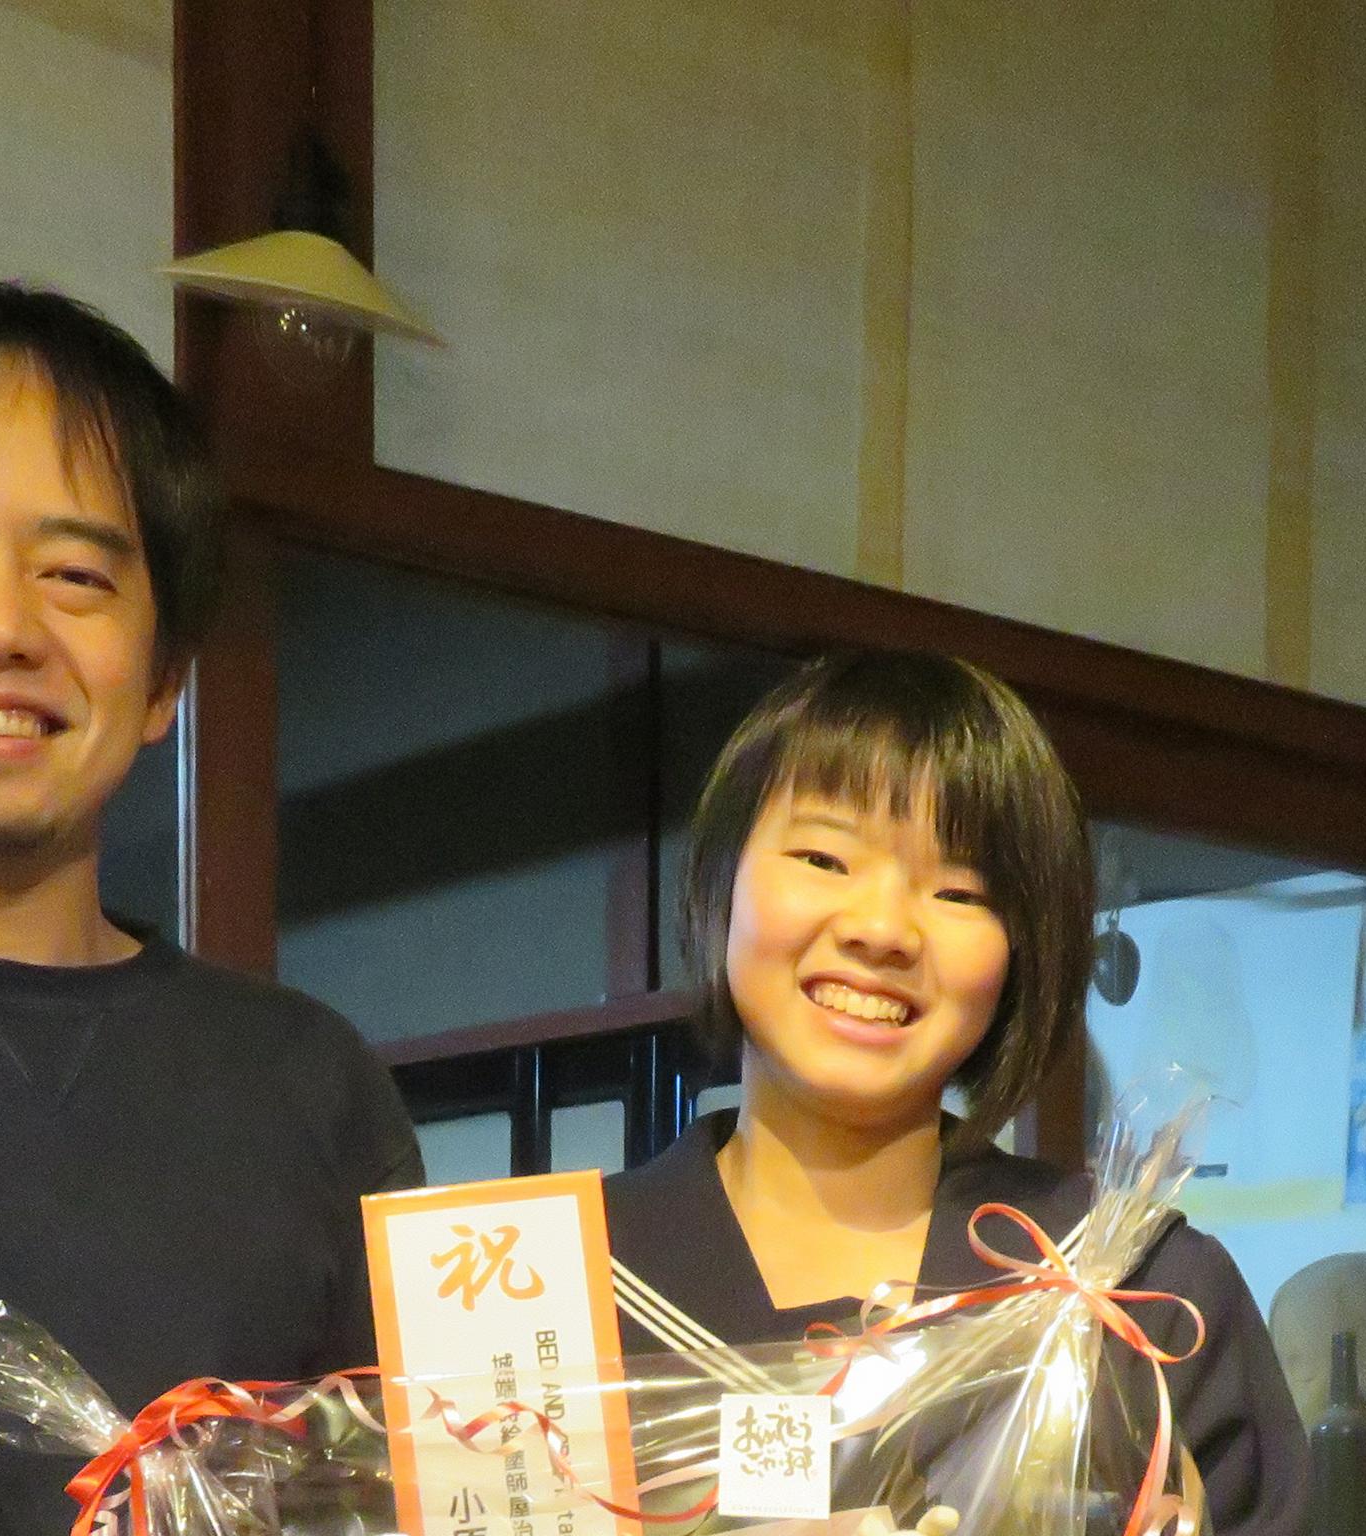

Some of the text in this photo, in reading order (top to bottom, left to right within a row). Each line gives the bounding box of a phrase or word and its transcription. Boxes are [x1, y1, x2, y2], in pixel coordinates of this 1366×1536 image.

[431, 1224, 544, 1312] 祝
[535, 1329, 559, 1370] BED
[541, 1382, 566, 1421] AND
[733, 1402, 812, 1453] おめでとう
[740, 1447, 815, 1481] ございます
